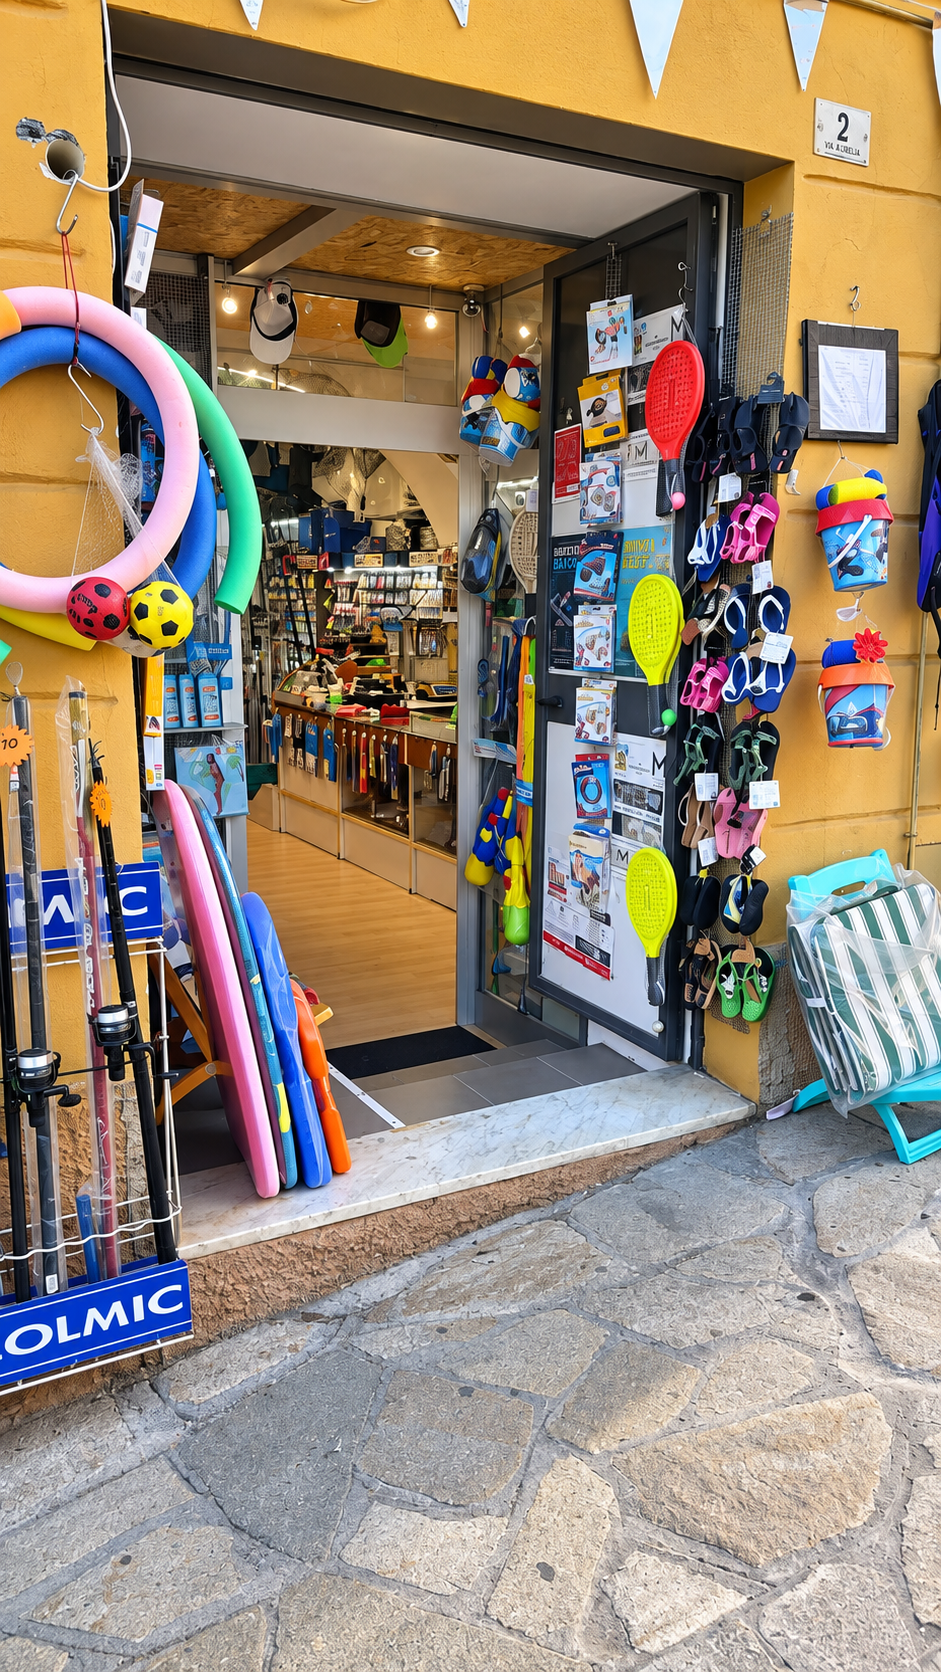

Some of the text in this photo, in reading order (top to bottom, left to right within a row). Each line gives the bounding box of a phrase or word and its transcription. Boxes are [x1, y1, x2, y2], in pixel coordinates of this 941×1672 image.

[837, 112, 849, 142] 2
[1, 738, 18, 750] 10
[652, 751, 667, 778] M
[0, 1285, 184, 1359] OLMIC
